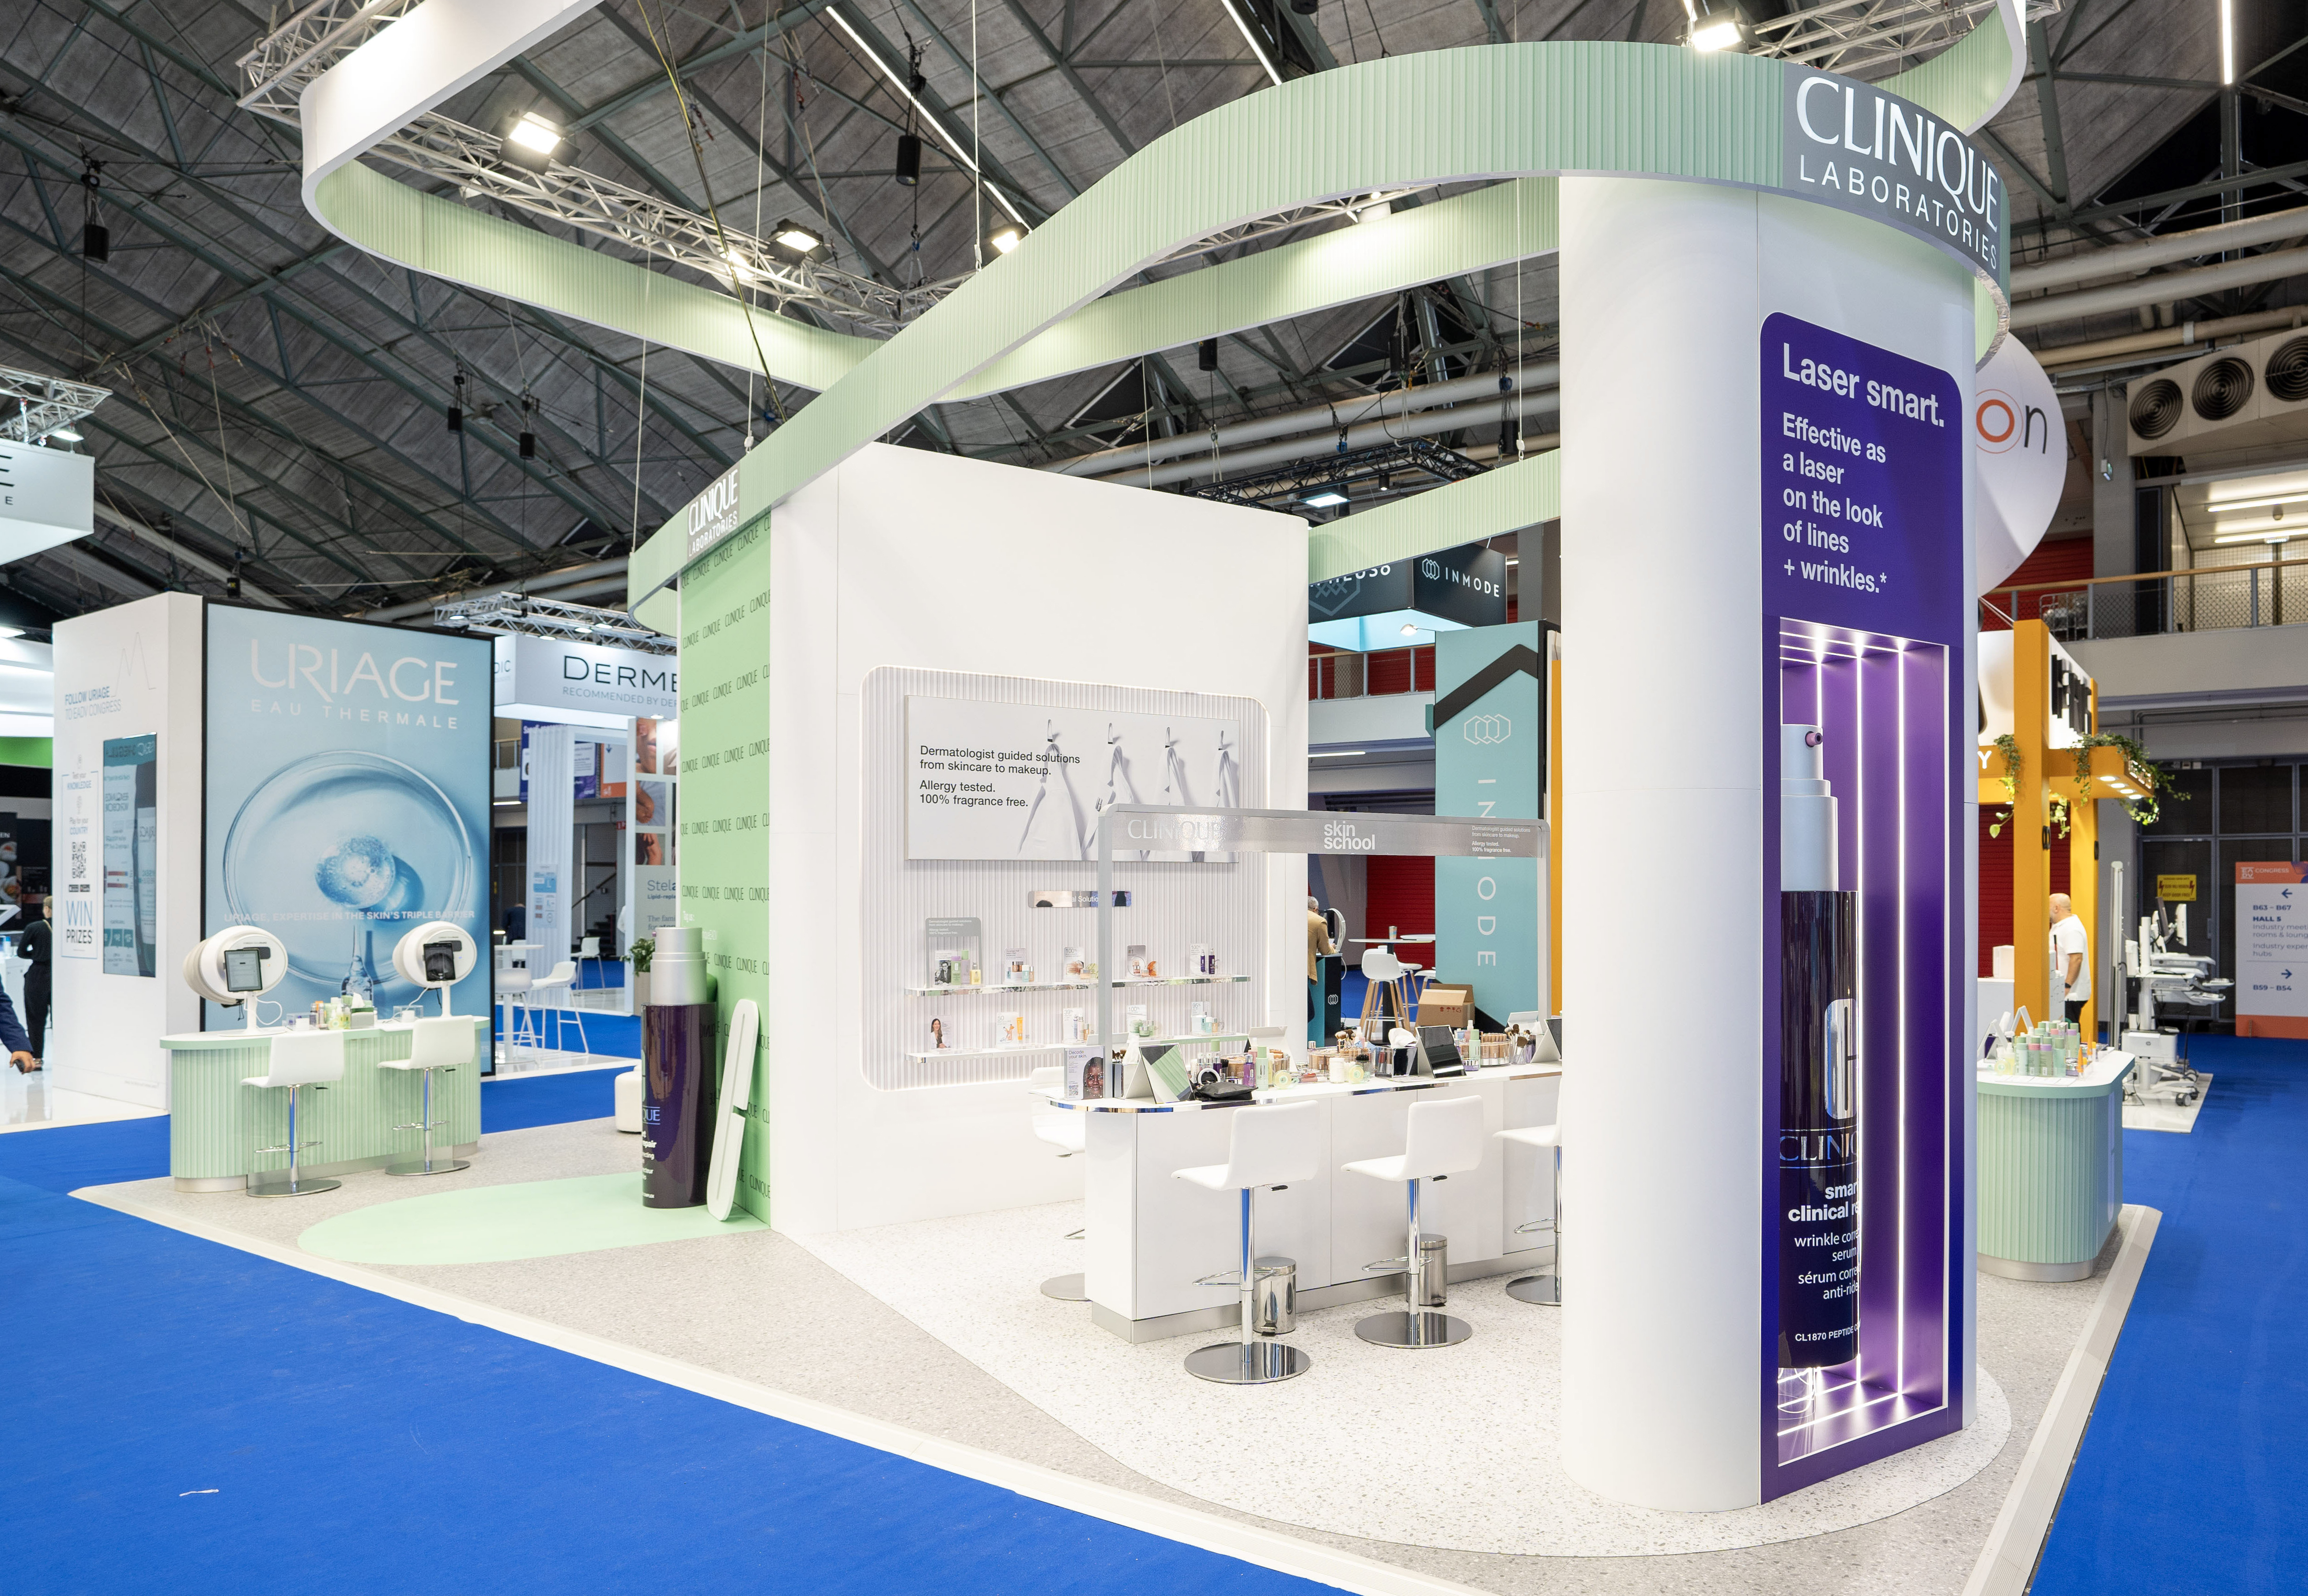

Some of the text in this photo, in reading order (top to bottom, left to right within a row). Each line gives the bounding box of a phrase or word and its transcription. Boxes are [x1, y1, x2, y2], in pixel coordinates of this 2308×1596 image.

[1797, 76, 1998, 233] CLINIQUE
[1800, 155, 1996, 270] LABORATORIES
[1783, 343, 1944, 427] Laser smart.
[1783, 412, 1886, 463] Effective as
[1783, 452, 1844, 484] a laser
[688, 469, 738, 536] CLINIQUE
[1783, 488, 1883, 528] on the look
[689, 510, 737, 557] LABORATORIES
[1783, 521, 1849, 553] of lines
[1445, 567, 1500, 598] INMODE
[251, 639, 460, 706] URIAGE
[65, 686, 110, 705] FOLLOW URIAGE
[563, 687, 659, 706] RECOMMENDED BY
[65, 708, 72, 720] TO
[90, 699, 121, 716] CONGRESS
[251, 699, 458, 729] EAU THERMALE
[920, 745, 1080, 763] Dermatologist guided solutions
[920, 760, 944, 770] from
[948, 761, 992, 772] skincare
[1009, 765, 1051, 777] makeup.
[68, 781, 91, 789] KNOWLEDGE
[920, 780, 995, 792] Allergy tested.
[920, 794, 1028, 807] 100% fragrance free.
[1127, 819, 1223, 841] CLINIQUE
[1324, 820, 1355, 836] skin
[1324, 834, 1375, 850] school
[1477, 779, 1496, 966] INODE
[66, 900, 92, 926] WIN
[224, 913, 270, 923] URIAGE,
[273, 912, 329, 921] EXPERTISE
[332, 911, 343, 921] IN
[344, 911, 364, 920] THE
[401, 910, 433, 919] TRIPLE
[436, 910, 475, 919] BARRIER
[1788, 1201, 1848, 1222] clinical
[1794, 1232, 1840, 1247] wrinkle
[1832, 1247, 1857, 1262] serum
[1798, 1271, 1836, 1284] sérum
[1795, 1325, 1854, 1342] CL1870 PEPTIDE
